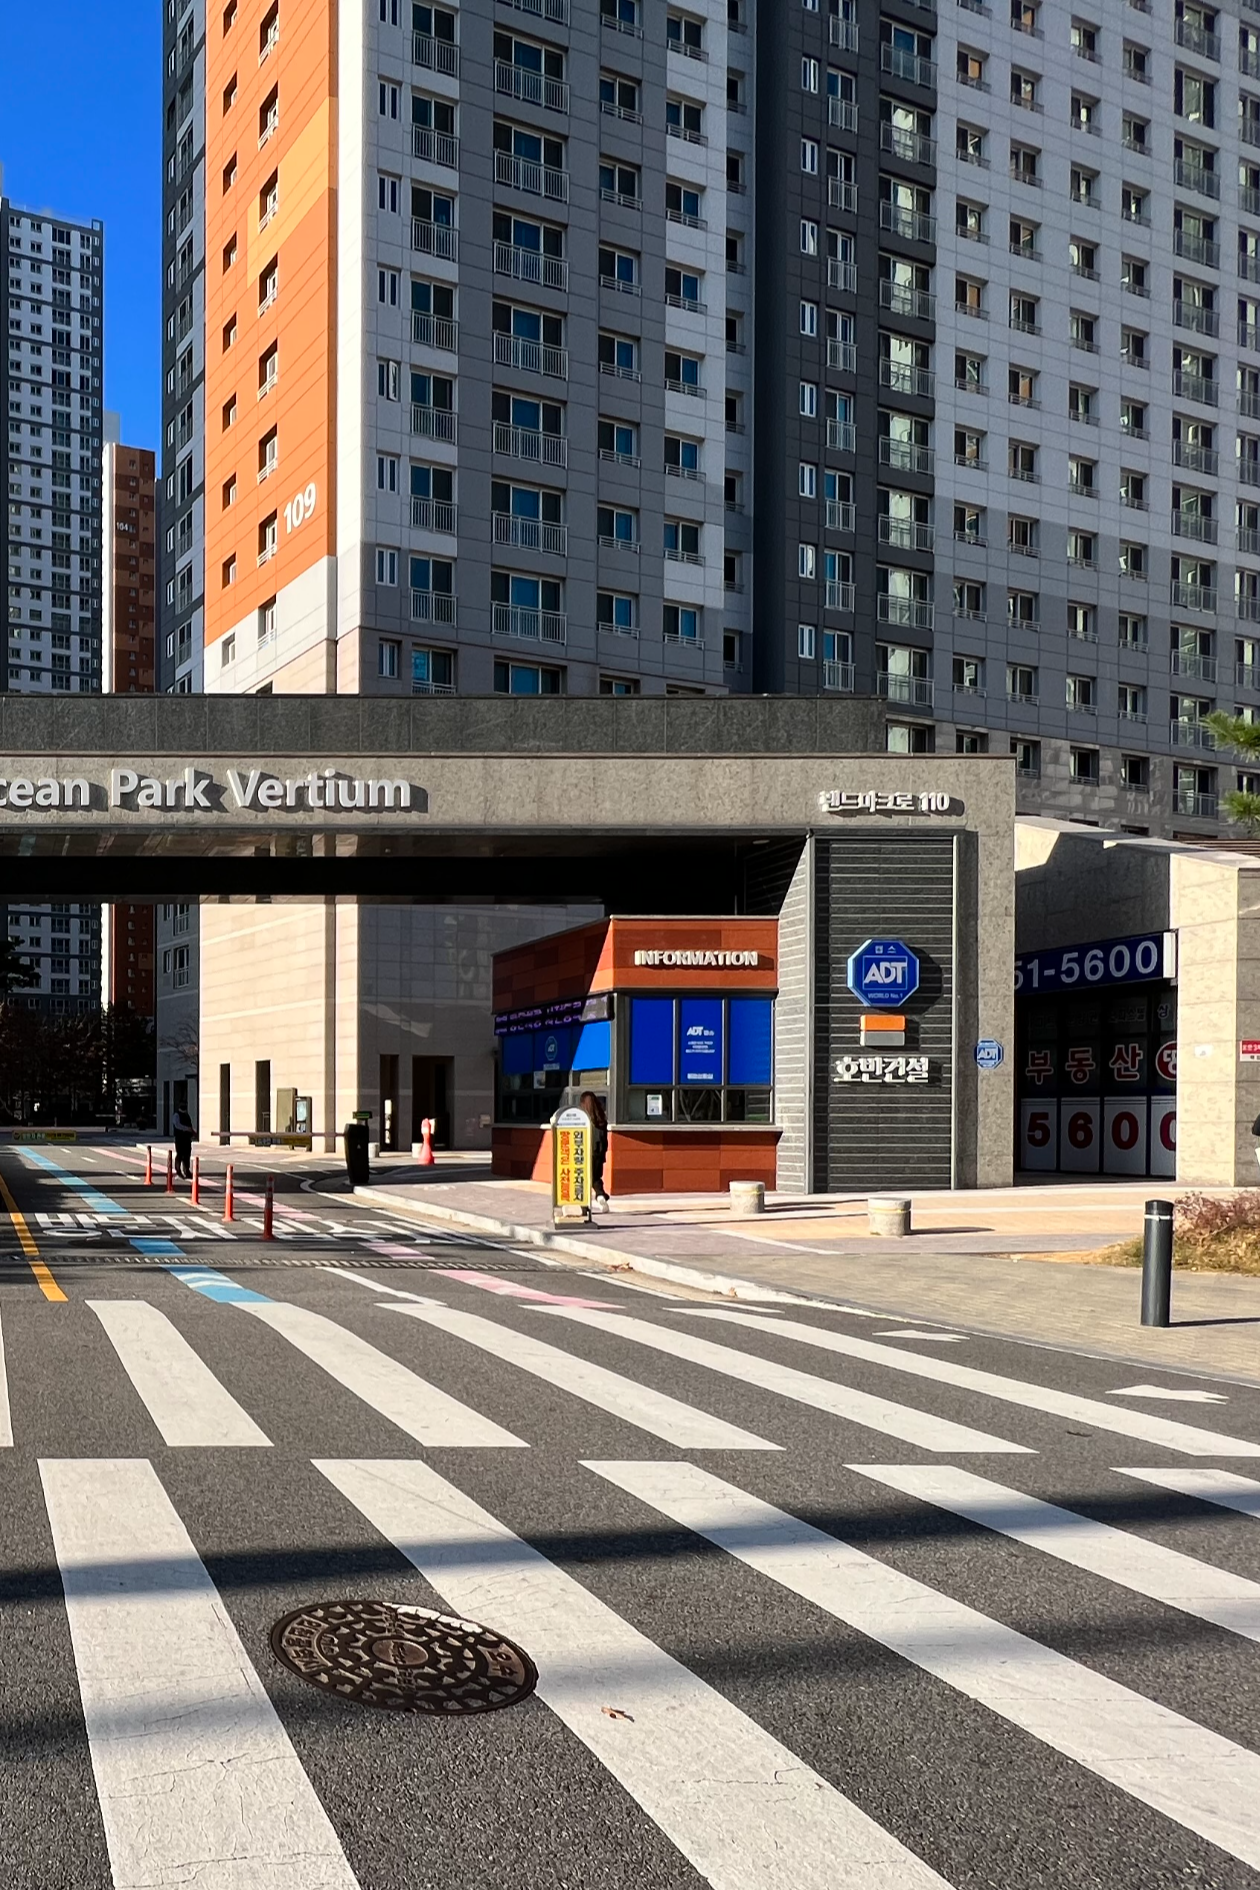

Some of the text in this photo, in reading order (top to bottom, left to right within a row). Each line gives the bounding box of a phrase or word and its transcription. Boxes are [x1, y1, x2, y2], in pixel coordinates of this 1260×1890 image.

[283, 482, 317, 535] 109
[116, 521, 129, 531] 104
[110, 767, 212, 808] Park
[226, 768, 412, 808] Vertium
[819, 790, 950, 812] 랜드마크로 110
[634, 949, 759, 966] INFORMATION
[863, 961, 908, 984] ADT
[687, 1026, 704, 1036] ADT
[977, 1047, 997, 1059] ADT
[1026, 1043, 1143, 1085] 부동산
[833, 1056, 929, 1083] 호반건설
